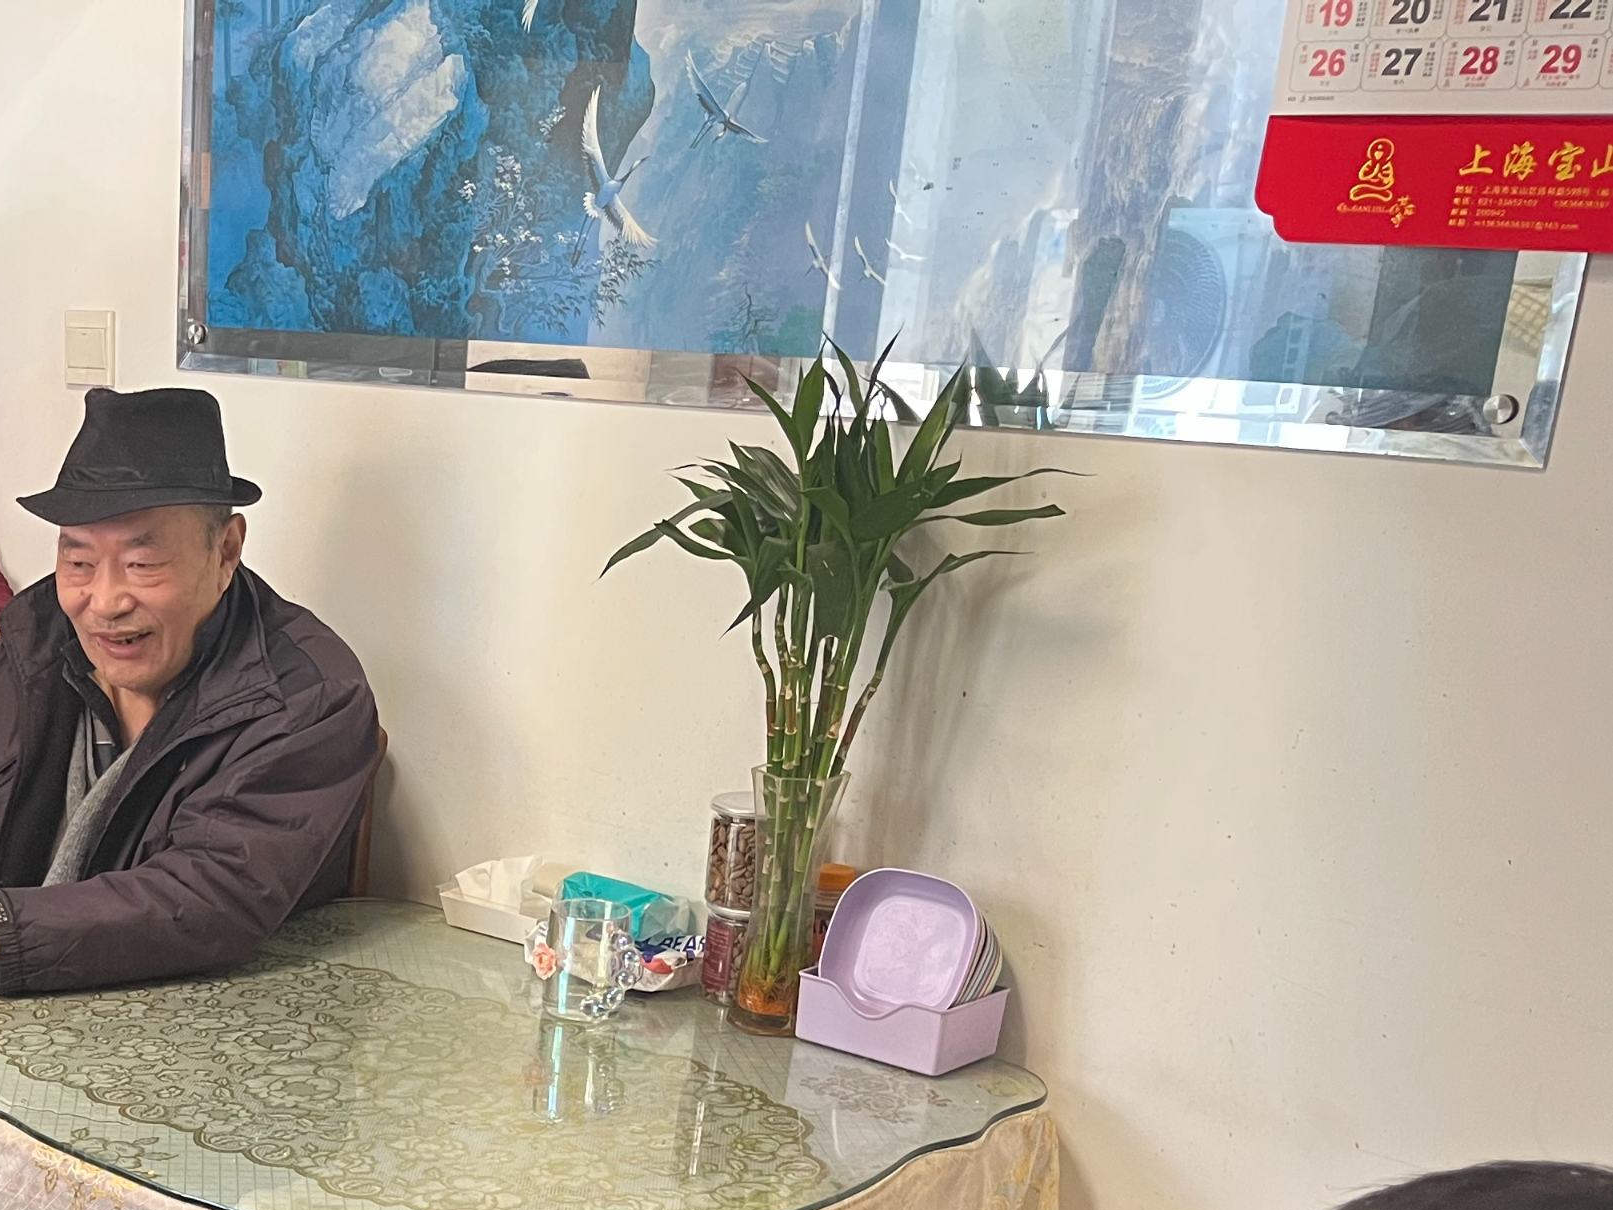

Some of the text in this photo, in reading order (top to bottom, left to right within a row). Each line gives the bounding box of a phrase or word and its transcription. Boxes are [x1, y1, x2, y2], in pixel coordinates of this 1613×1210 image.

[1318, 0, 1354, 27] 19
[1389, 0, 1431, 24] 20
[1468, 0, 1508, 22] 21
[1308, 44, 1582, 77] 26 27 28 29
